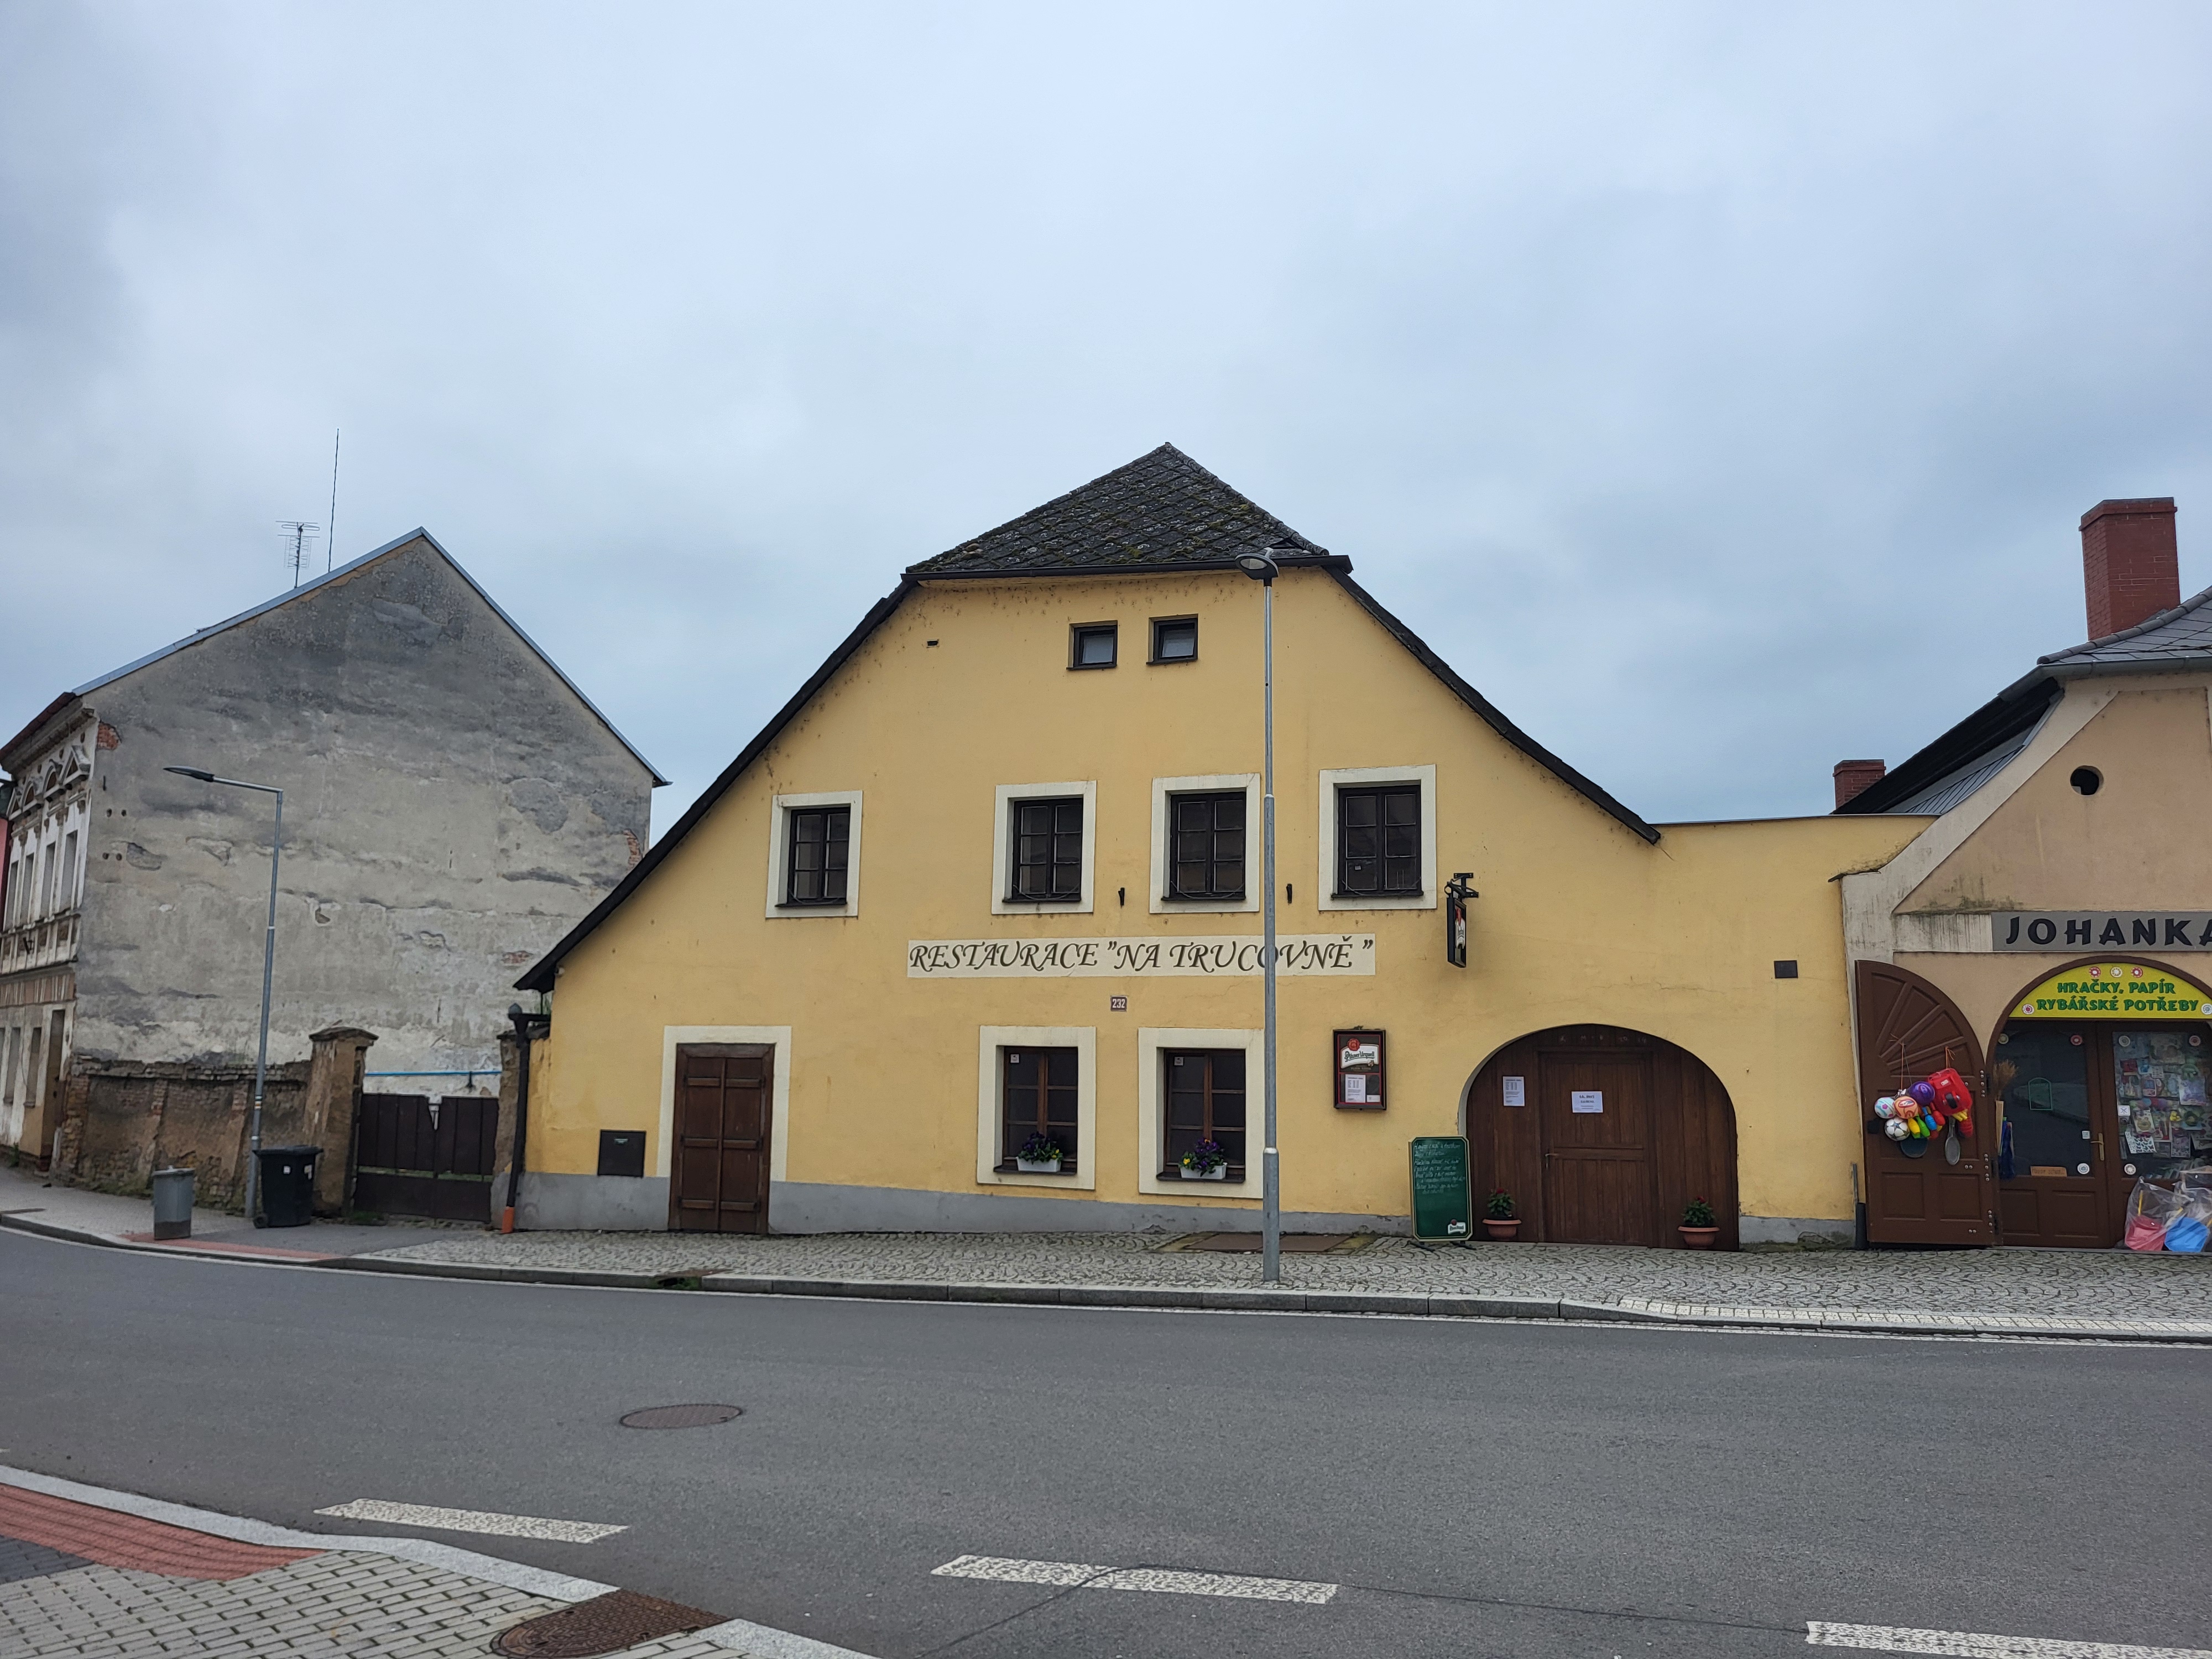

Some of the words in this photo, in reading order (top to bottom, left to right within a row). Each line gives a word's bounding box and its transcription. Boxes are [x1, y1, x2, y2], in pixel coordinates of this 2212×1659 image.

[909, 941, 1098, 972] RESTAURACE
[2057, 978, 2124, 995] HRAČKY,
[2128, 978, 2176, 995] PAPÍR
[1112, 998, 1125, 1009] 232
[2036, 996, 2119, 1011] RYBÁŘSKÉ
[2124, 996, 2199, 1012] POTŘEBY
